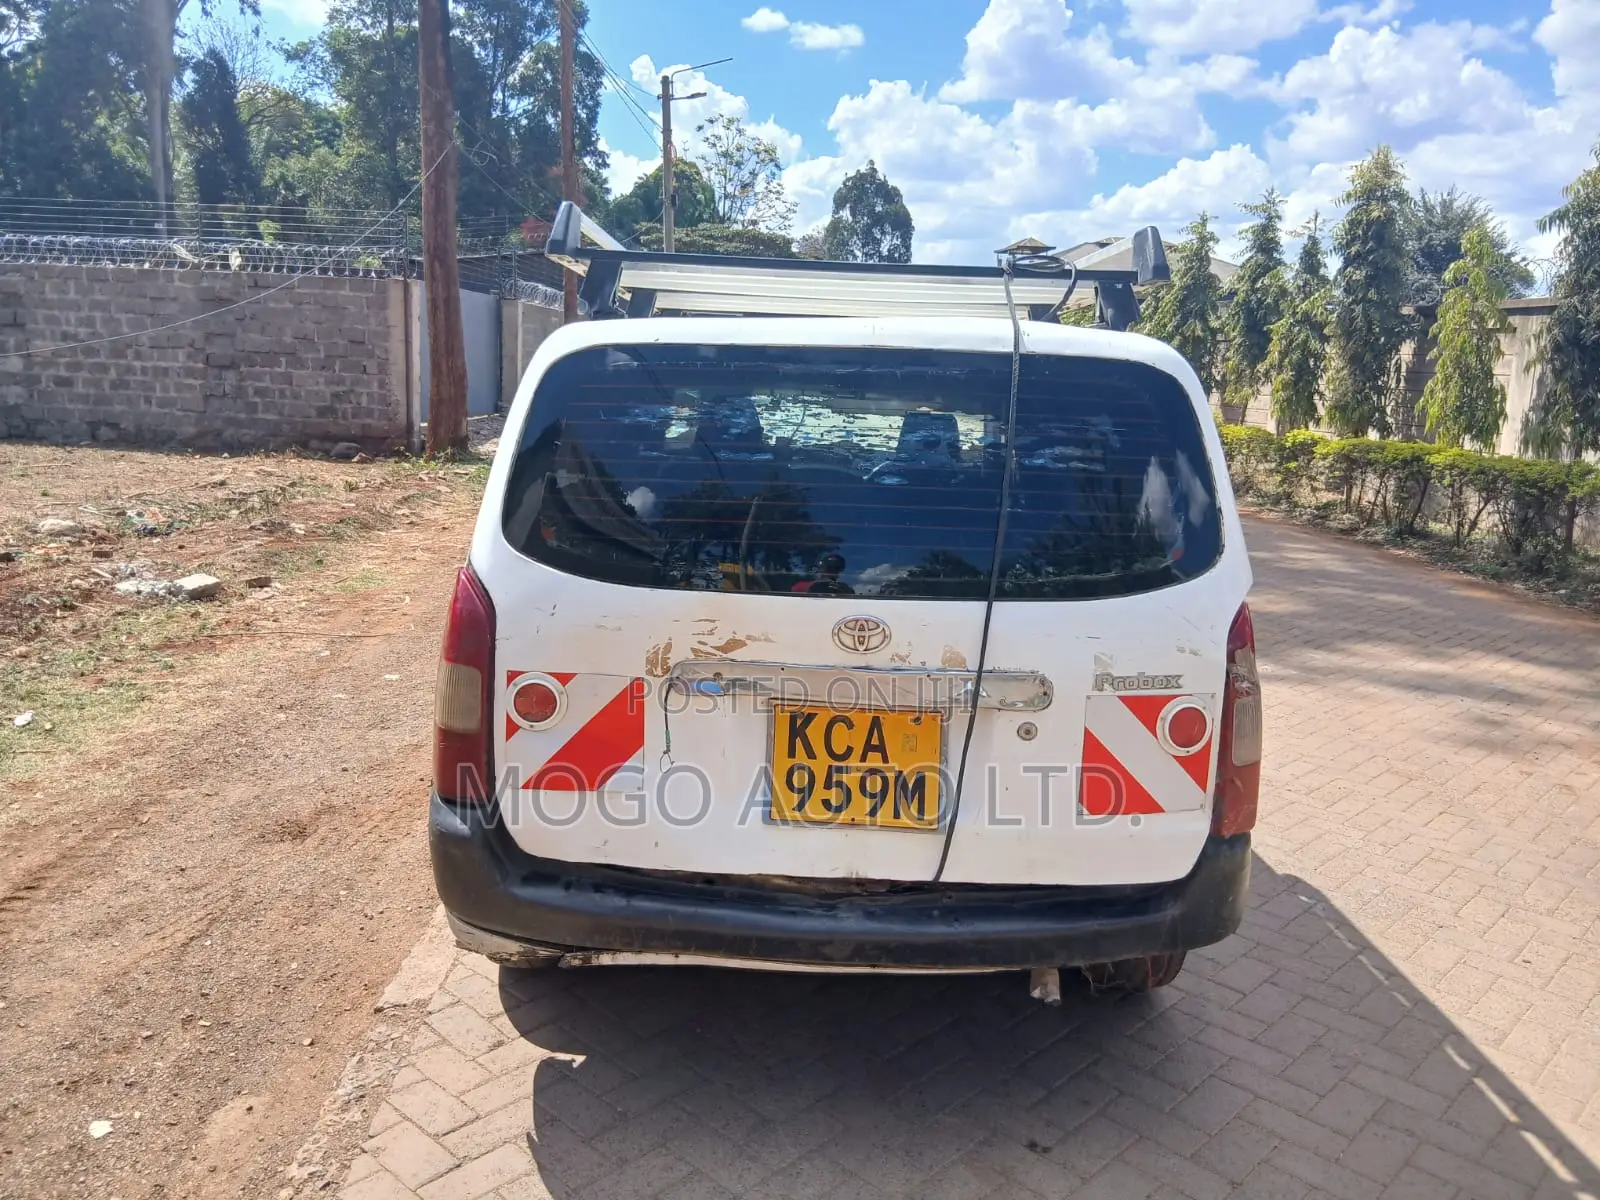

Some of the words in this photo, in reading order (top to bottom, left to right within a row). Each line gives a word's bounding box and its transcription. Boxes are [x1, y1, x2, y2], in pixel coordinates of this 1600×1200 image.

[1093, 671, 1184, 692] Probox
[787, 711, 890, 764] KCA
[785, 763, 927, 821] 959M
